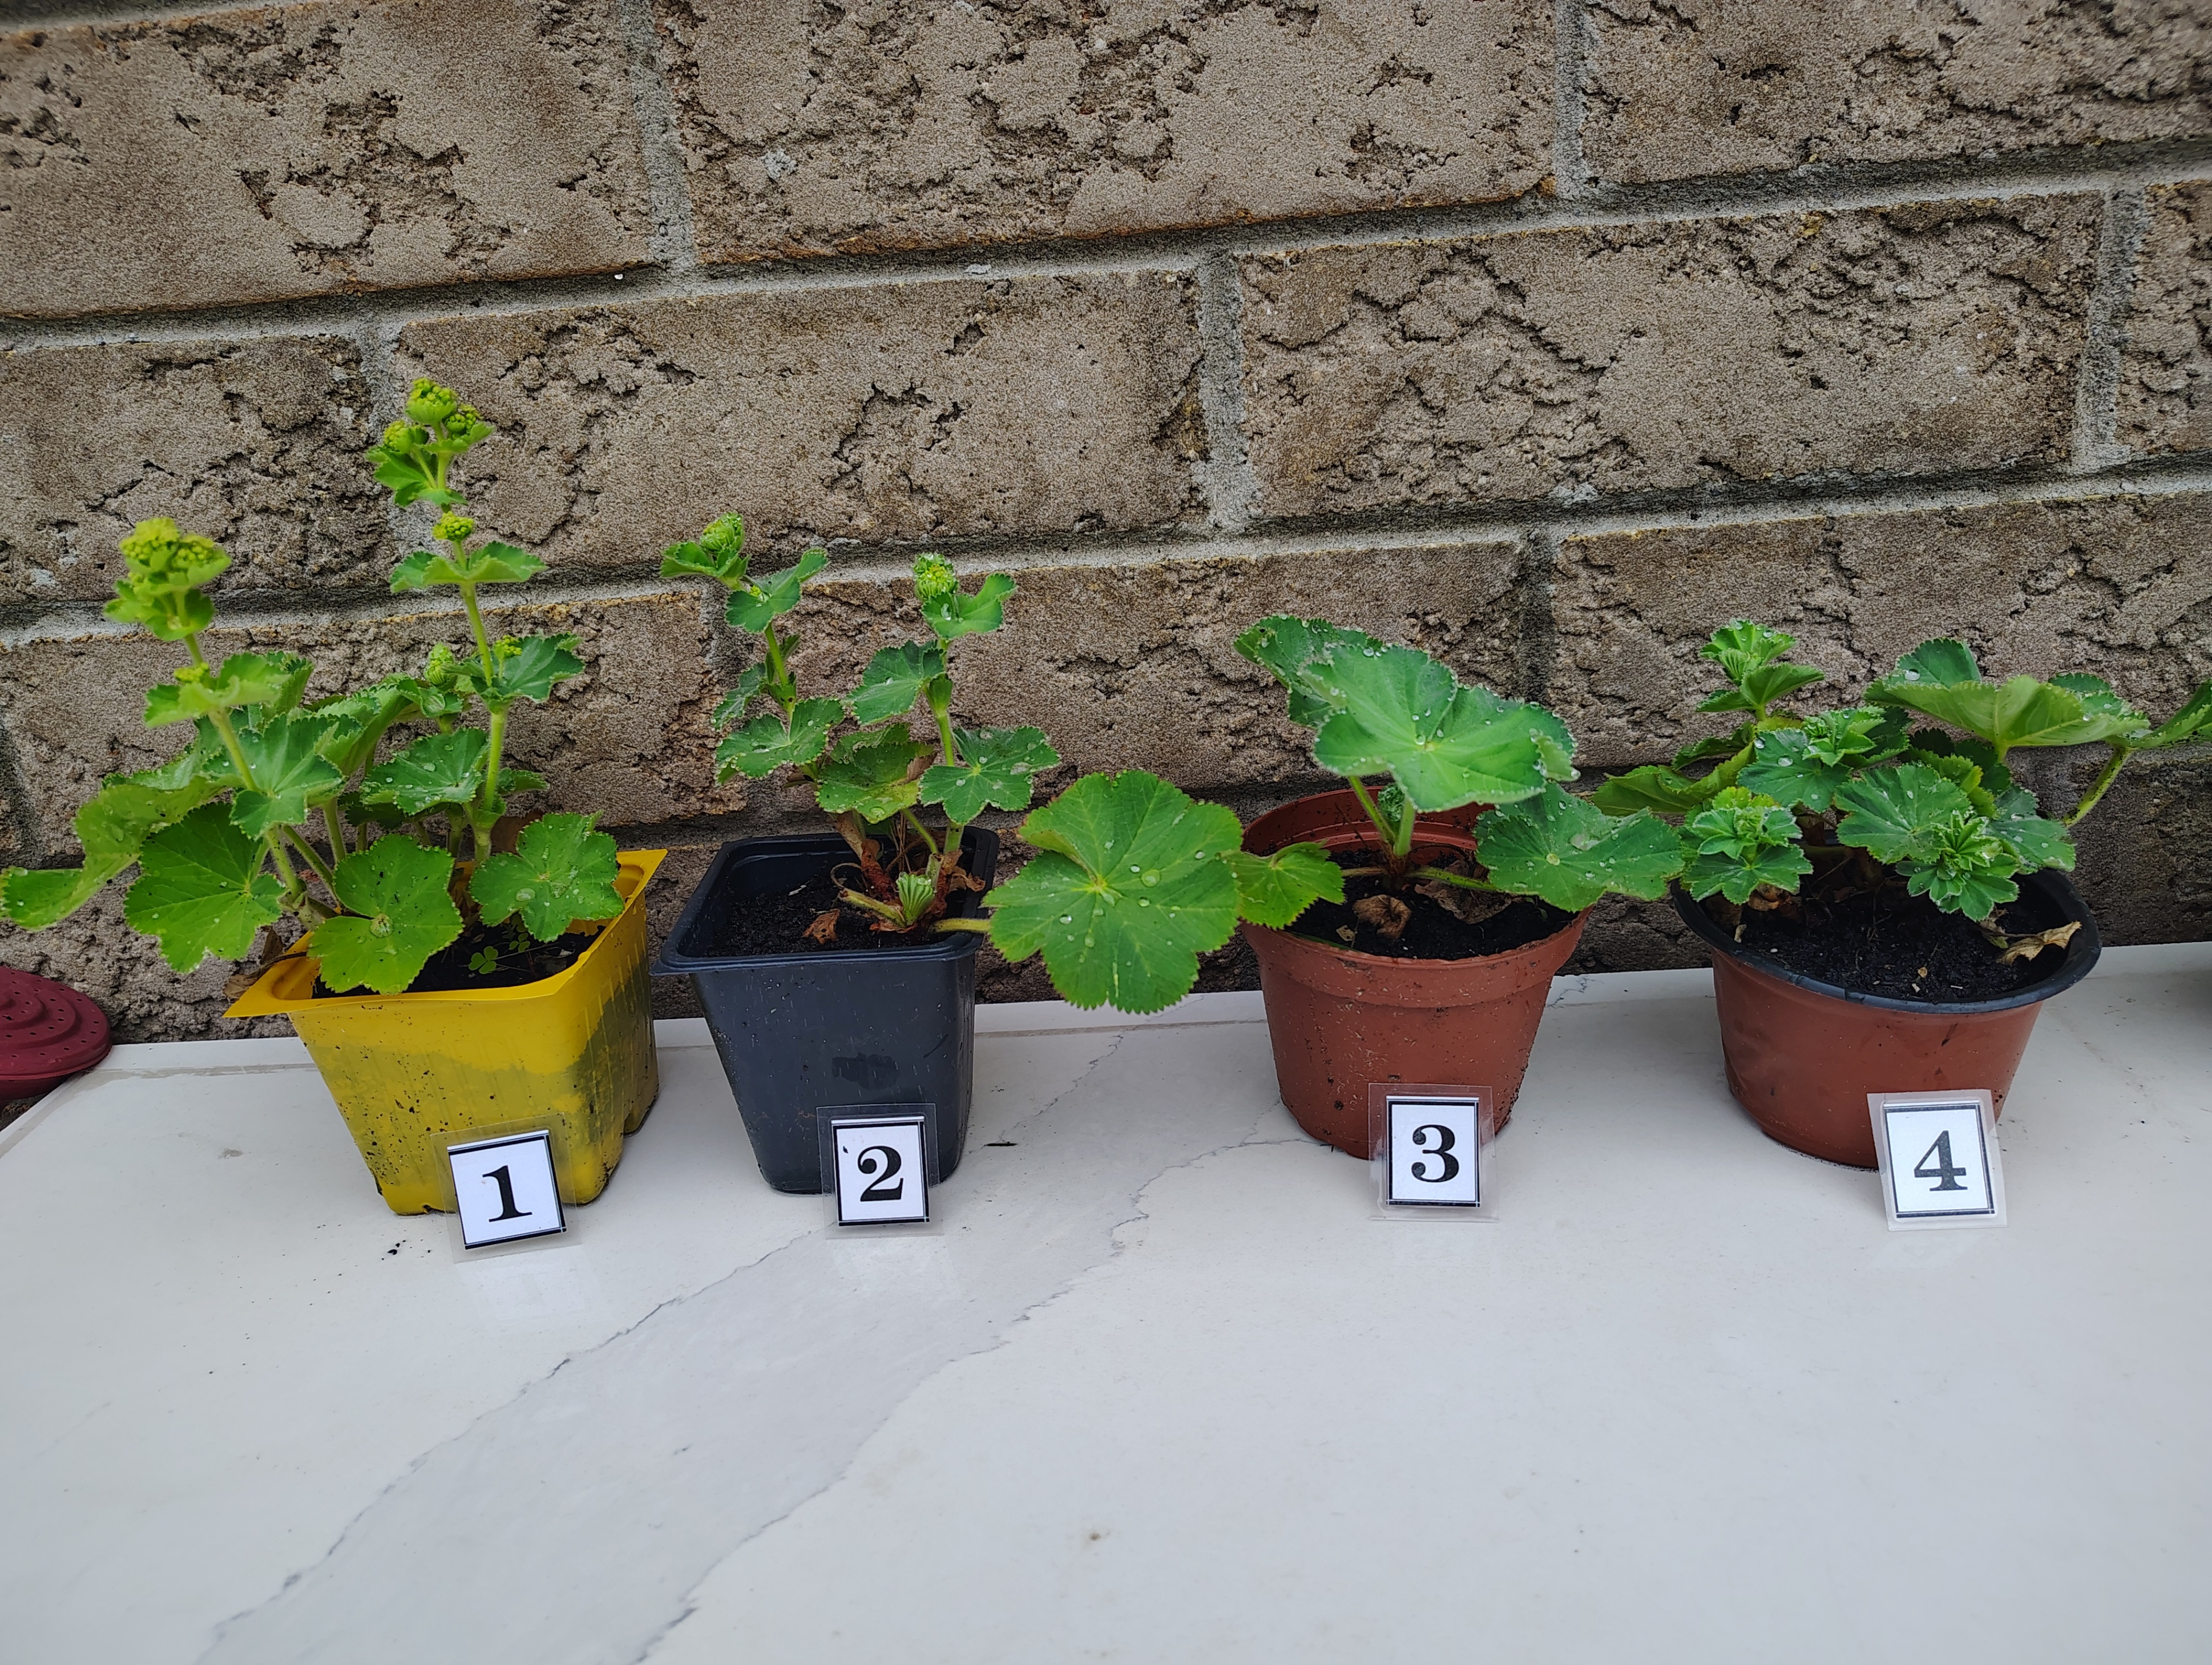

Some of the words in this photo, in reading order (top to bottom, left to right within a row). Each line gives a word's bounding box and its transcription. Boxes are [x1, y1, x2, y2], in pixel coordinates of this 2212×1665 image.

[857, 1145, 904, 1202] 2
[1411, 1124, 1459, 1183] 3
[1914, 1130, 1968, 1191] 4
[482, 1165, 533, 1222] 1
